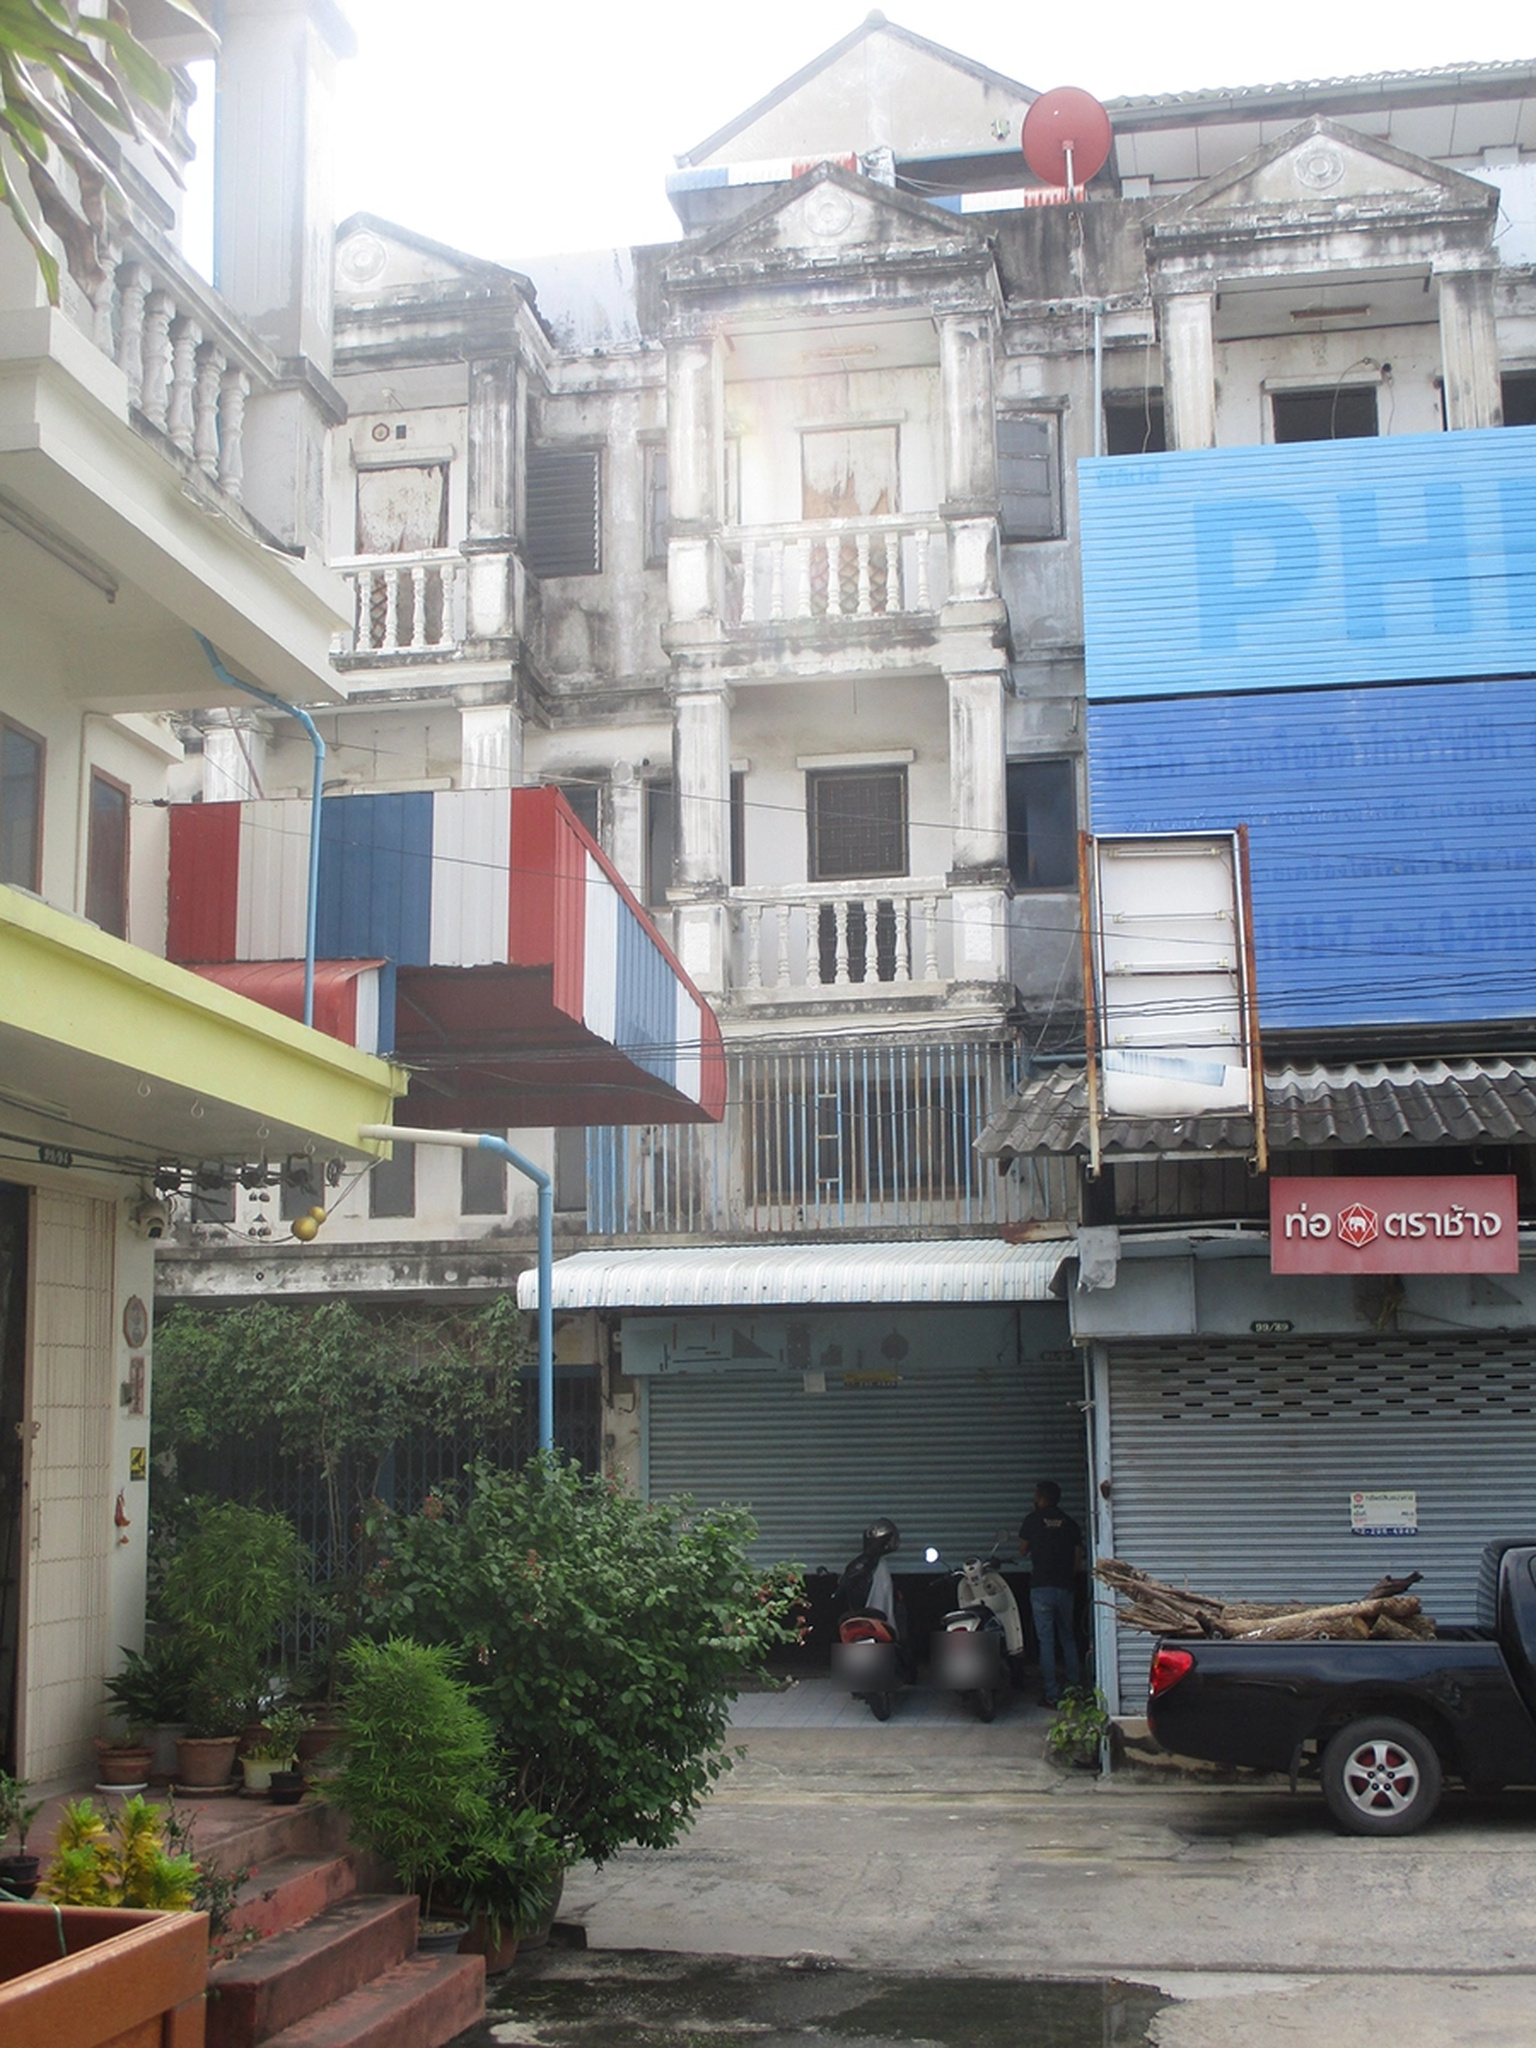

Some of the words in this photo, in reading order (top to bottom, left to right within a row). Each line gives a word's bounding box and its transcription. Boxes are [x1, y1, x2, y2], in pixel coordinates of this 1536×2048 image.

[1285, 1202, 1332, 1239] ท่อ
[1384, 1204, 1503, 1238] ตราช้าง
